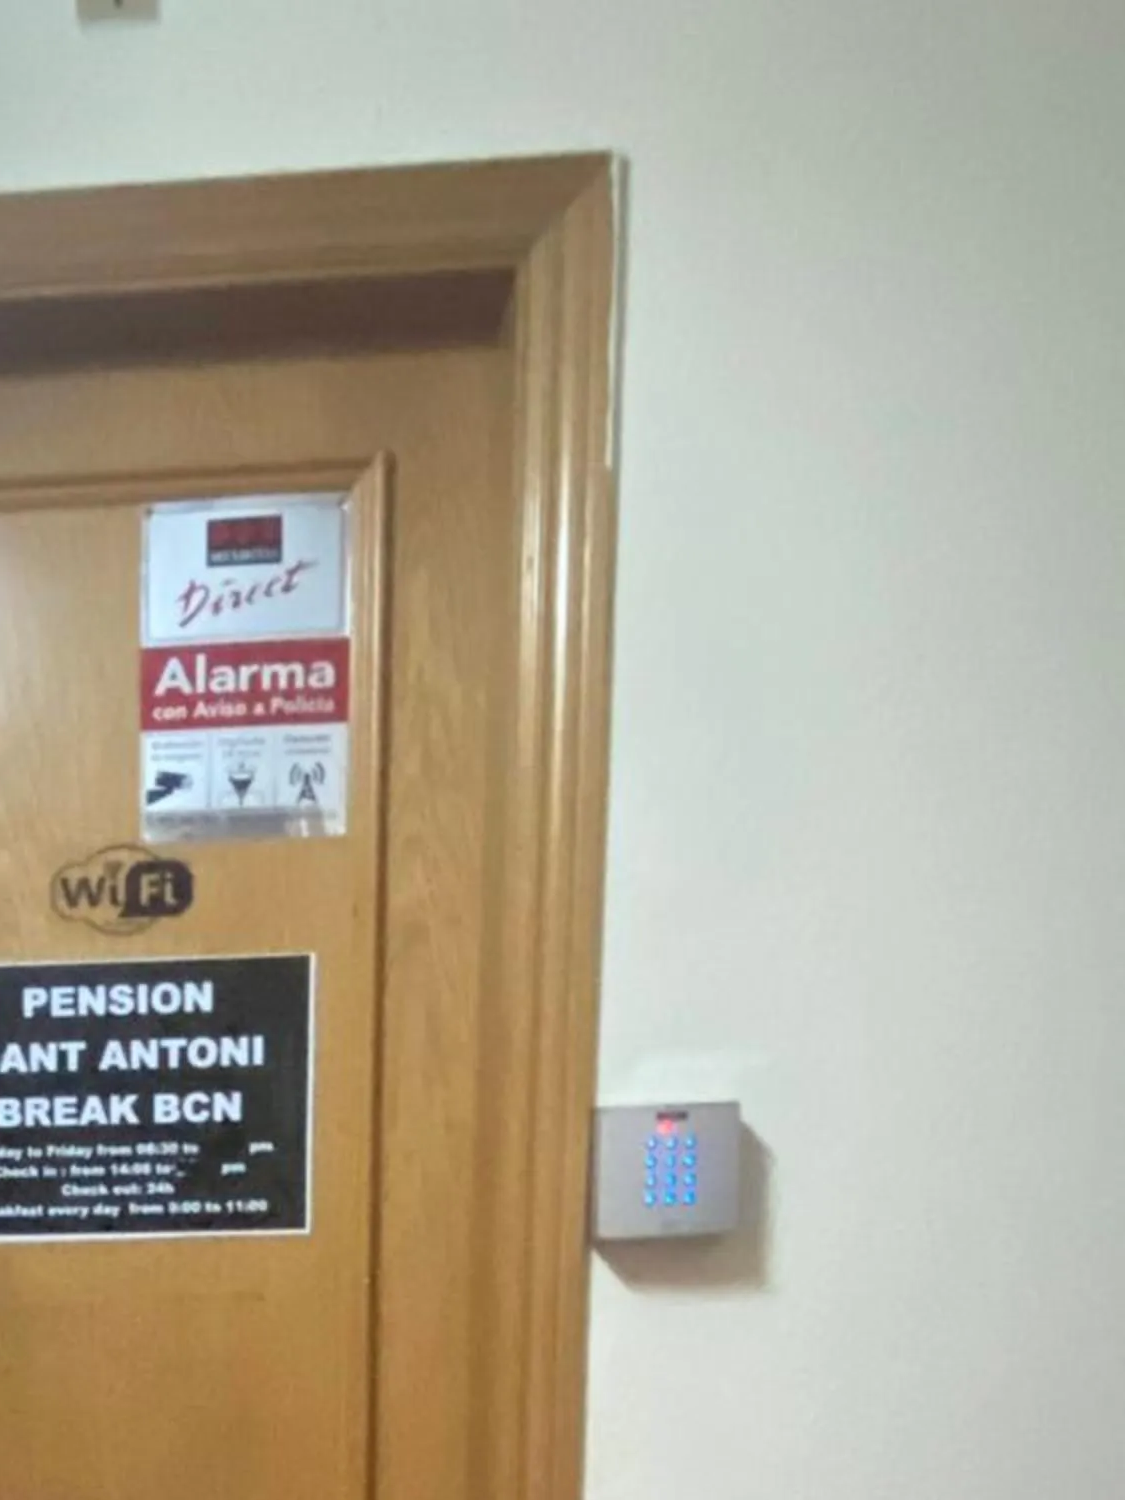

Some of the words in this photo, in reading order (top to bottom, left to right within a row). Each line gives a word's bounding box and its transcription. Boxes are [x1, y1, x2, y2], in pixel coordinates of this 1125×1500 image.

[154, 654, 337, 697] Alarma
[152, 705, 188, 721] con
[192, 701, 247, 718] Aviso
[22, 981, 214, 1019] PENSION
[98, 1035, 264, 1072] ANTONI
[152, 1091, 242, 1124] BCN
[27, 1146, 43, 1158] to
[46, 1144, 93, 1159] Friday
[96, 1143, 132, 1156] from
[182, 1142, 199, 1154] to
[249, 1141, 274, 1155] pm
[42, 1165, 58, 1177] in
[70, 1164, 105, 1176] from
[221, 1162, 246, 1176] pm
[61, 1184, 108, 1196] Check
[147, 1182, 175, 1194] 24h
[47, 1205, 89, 1218] every
[93, 1203, 120, 1218] day
[129, 1201, 164, 1215] from
[204, 1200, 222, 1213] to
